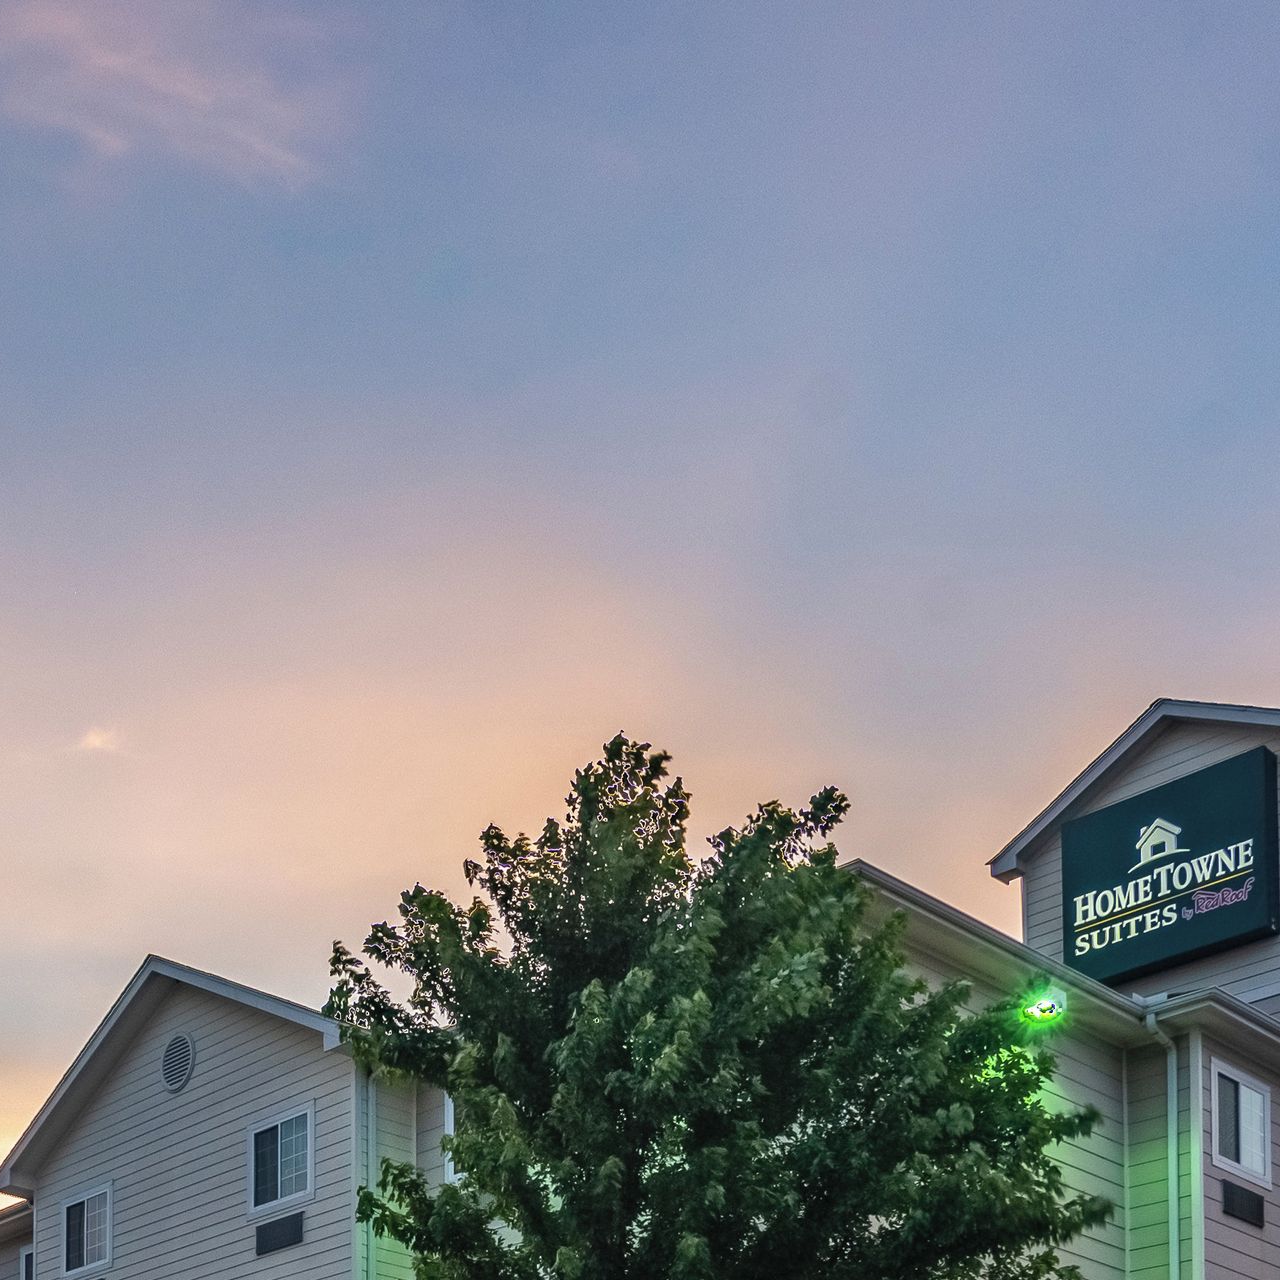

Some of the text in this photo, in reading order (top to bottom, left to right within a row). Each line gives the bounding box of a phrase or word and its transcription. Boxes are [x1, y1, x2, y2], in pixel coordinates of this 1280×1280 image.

[1075, 877, 1255, 957] SUITES by Red Roof
